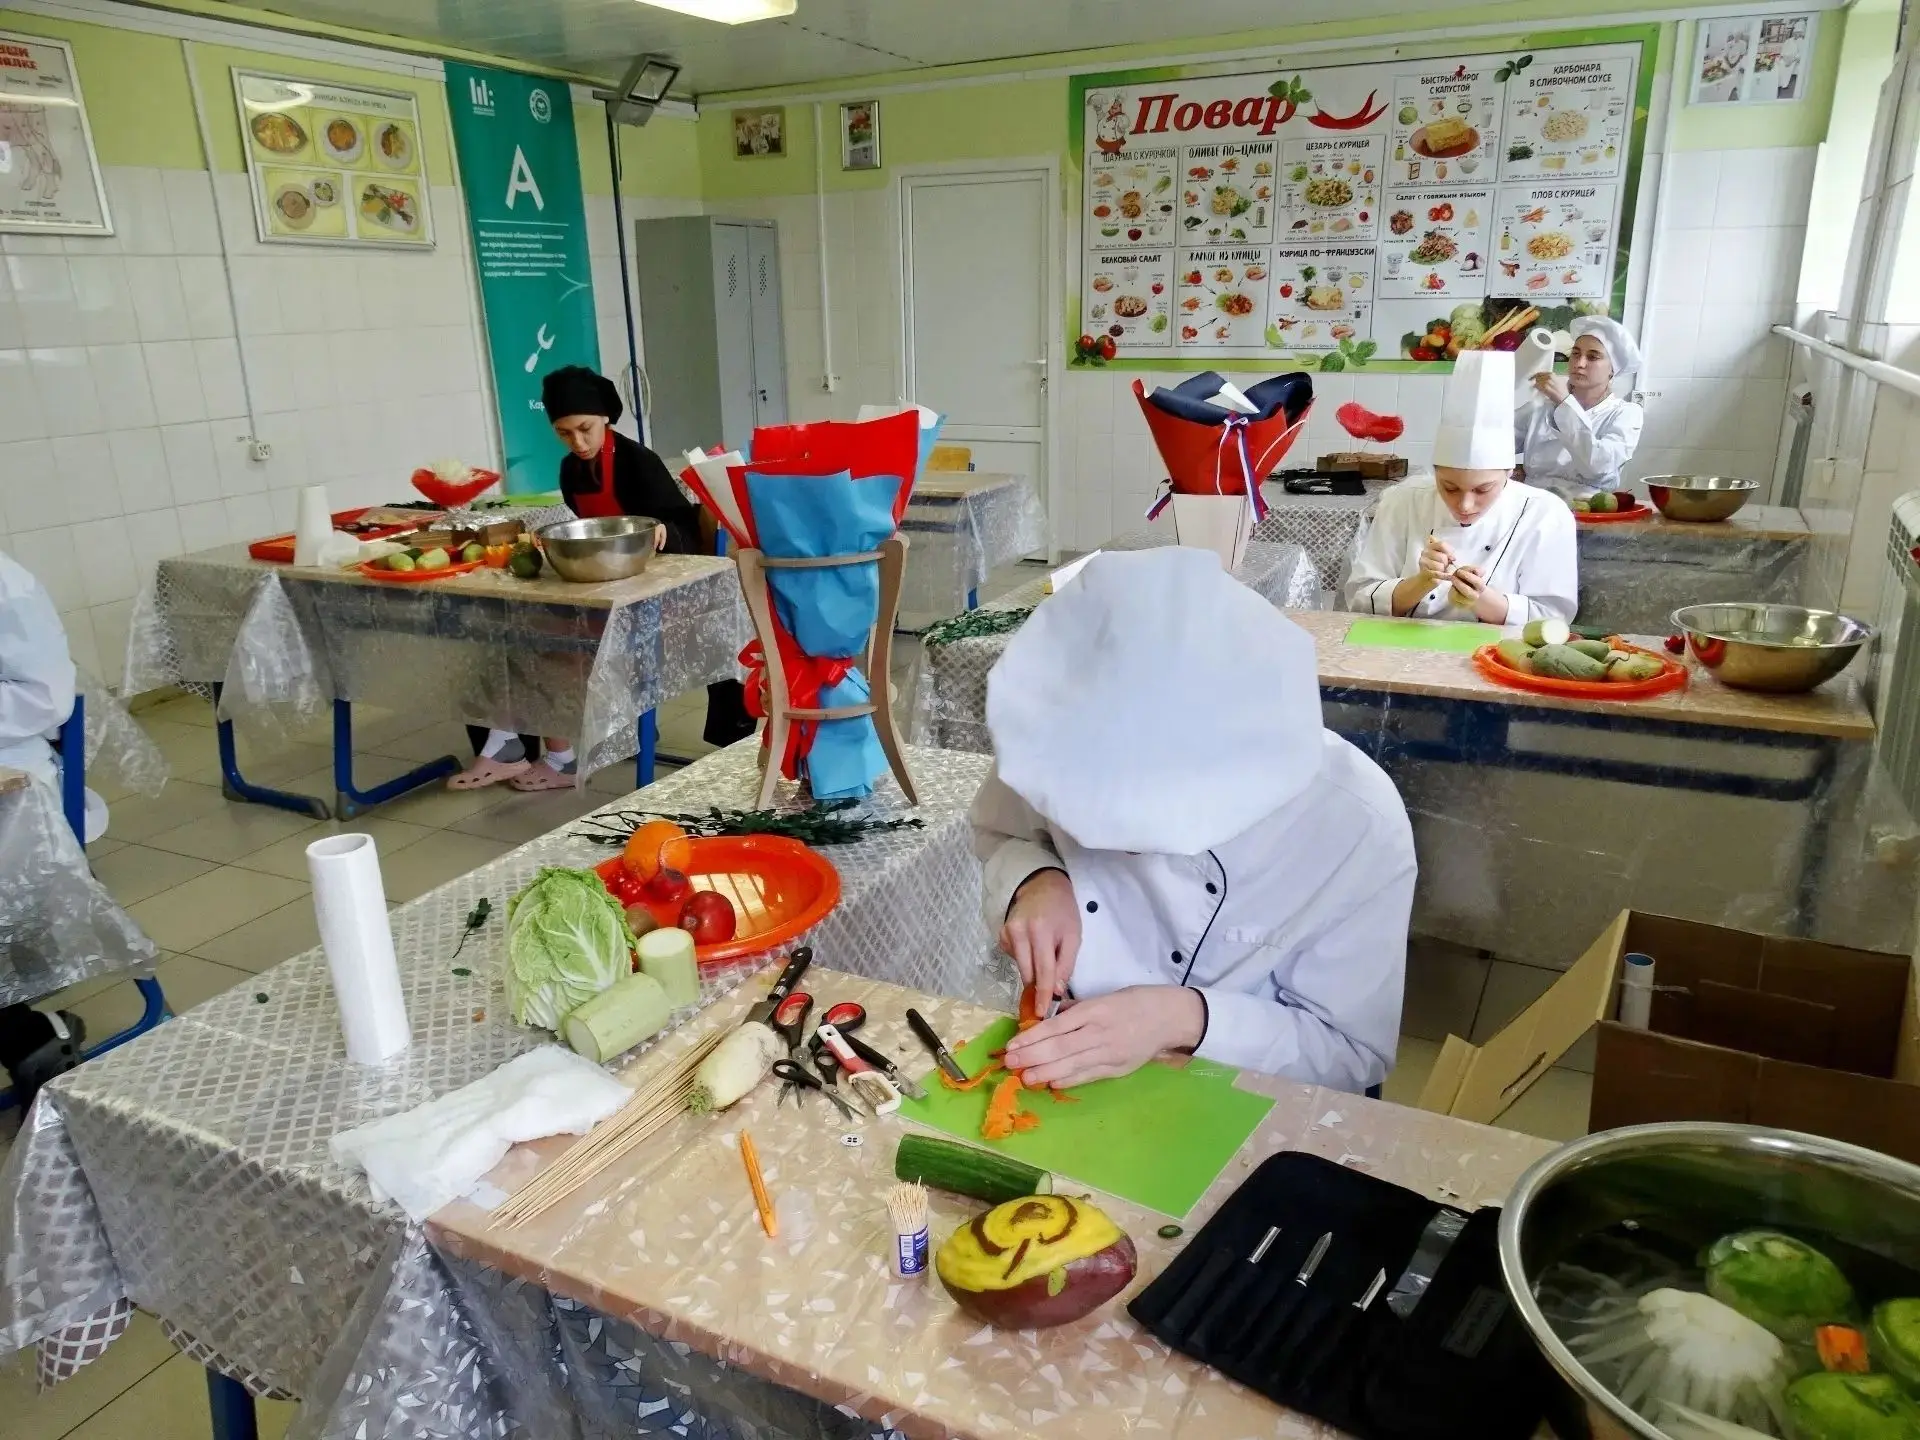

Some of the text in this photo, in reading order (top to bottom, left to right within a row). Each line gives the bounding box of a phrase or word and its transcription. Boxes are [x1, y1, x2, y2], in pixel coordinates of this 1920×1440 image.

[1553, 63, 1601, 75] КАРБОНАРА
[1420, 74, 1457, 85] БЫСТРЫЙ
[1529, 74, 1612, 87] В СЛИВОЧНОМ СОУСЕ
[1429, 83, 1471, 94] С КАПУСТОЙ
[1129, 94, 1297, 136] Повар
[1188, 143, 1273, 158] ОЛИВЬЕ ПО-ЦАРСКИ
[1305, 139, 1370, 151] ЦЕЗАРЬ С КУРИЦЕЙ
[1103, 151, 1132, 163] ШАУРМА
[1138, 149, 1176, 160] КУРОЧКОЙ
[1395, 193, 1416, 201] Салат
[1531, 188, 1596, 199] ПЛОВ С КУРИЦЕЙ
[1279, 248, 1375, 258] КУРИЦА ПО-ФРАНЦУЗСКИ
[1101, 254, 1162, 264] БЕЛКОВЫЙ САЛАТ
